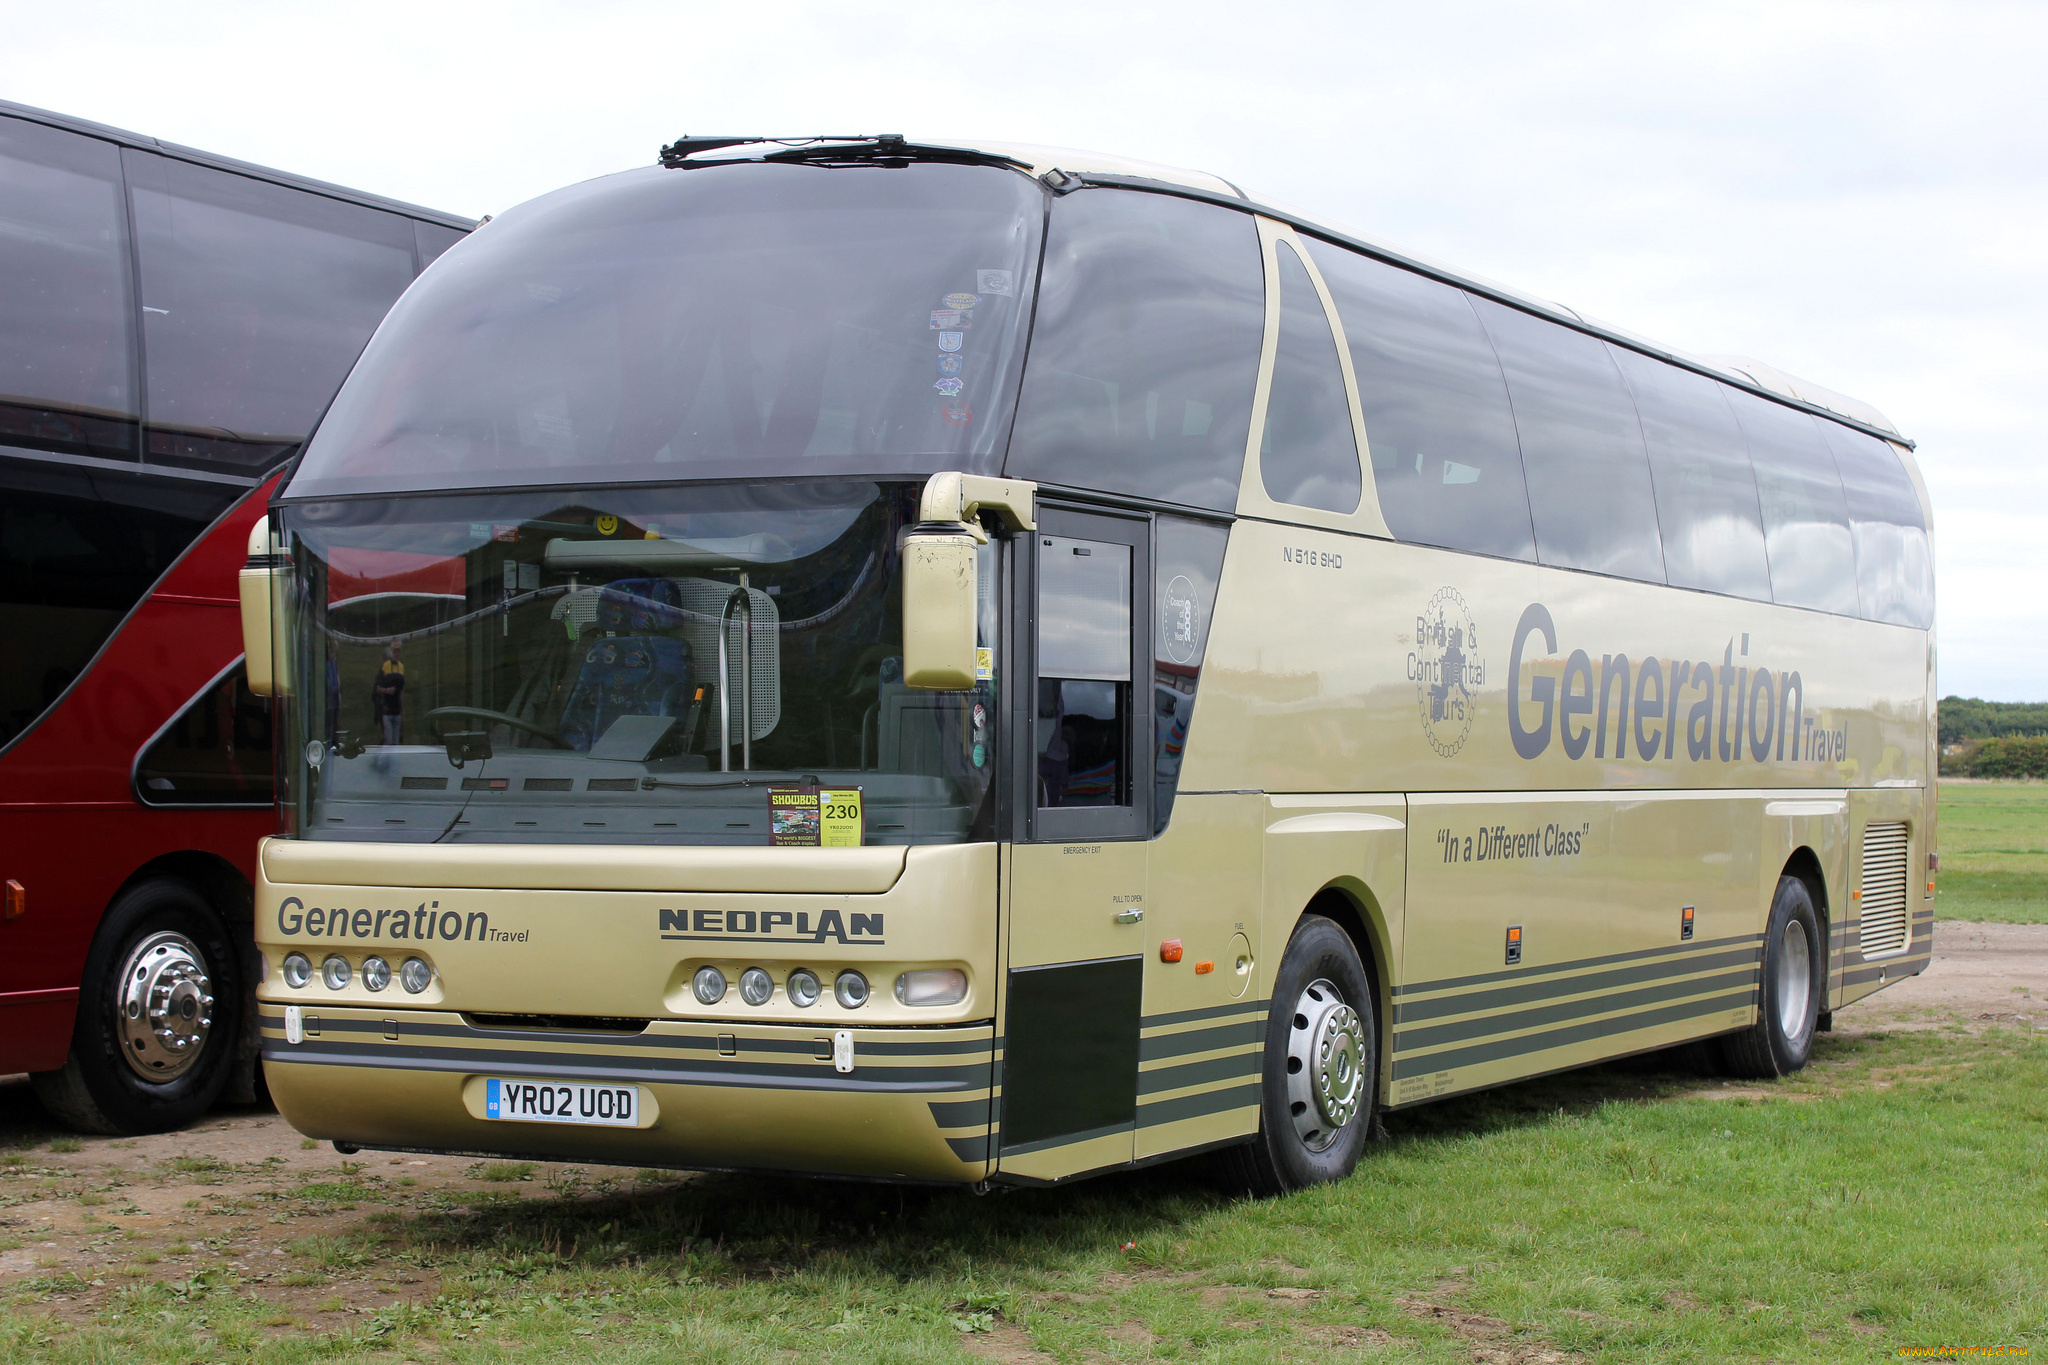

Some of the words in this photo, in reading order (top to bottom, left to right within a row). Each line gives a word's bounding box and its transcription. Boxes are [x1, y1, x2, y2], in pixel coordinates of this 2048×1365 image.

[1283, 547, 1292, 562] N
[1295, 549, 1317, 565] 516
[1320, 553, 1343, 569] SHD
[1170, 597, 1185, 607] Coach
[1176, 620, 1184, 630] the
[1416, 616, 1463, 649] British
[1468, 623, 1477, 650] &
[1174, 632, 1184, 641] Year
[1407, 652, 1486, 686] Continental
[1508, 602, 1802, 762] Generation
[1803, 717, 1847, 763] Travel
[772, 795, 818, 805] SHOWBUS
[826, 805, 858, 819] 230
[1063, 847, 1091, 855] EMERGENCY
[1091, 846, 1101, 854] EXIT
[1463, 836, 1473, 862] a
[1476, 825, 1541, 861] Different
[1113, 895, 1124, 903] PULL
[278, 896, 489, 941] Generation
[489, 928, 530, 943] Travel
[659, 908, 885, 944] NEOPLAN
[488, 1102, 498, 1111] GB
[505, 1084, 573, 1117] YR02
[580, 1088, 632, 1119] UOD
